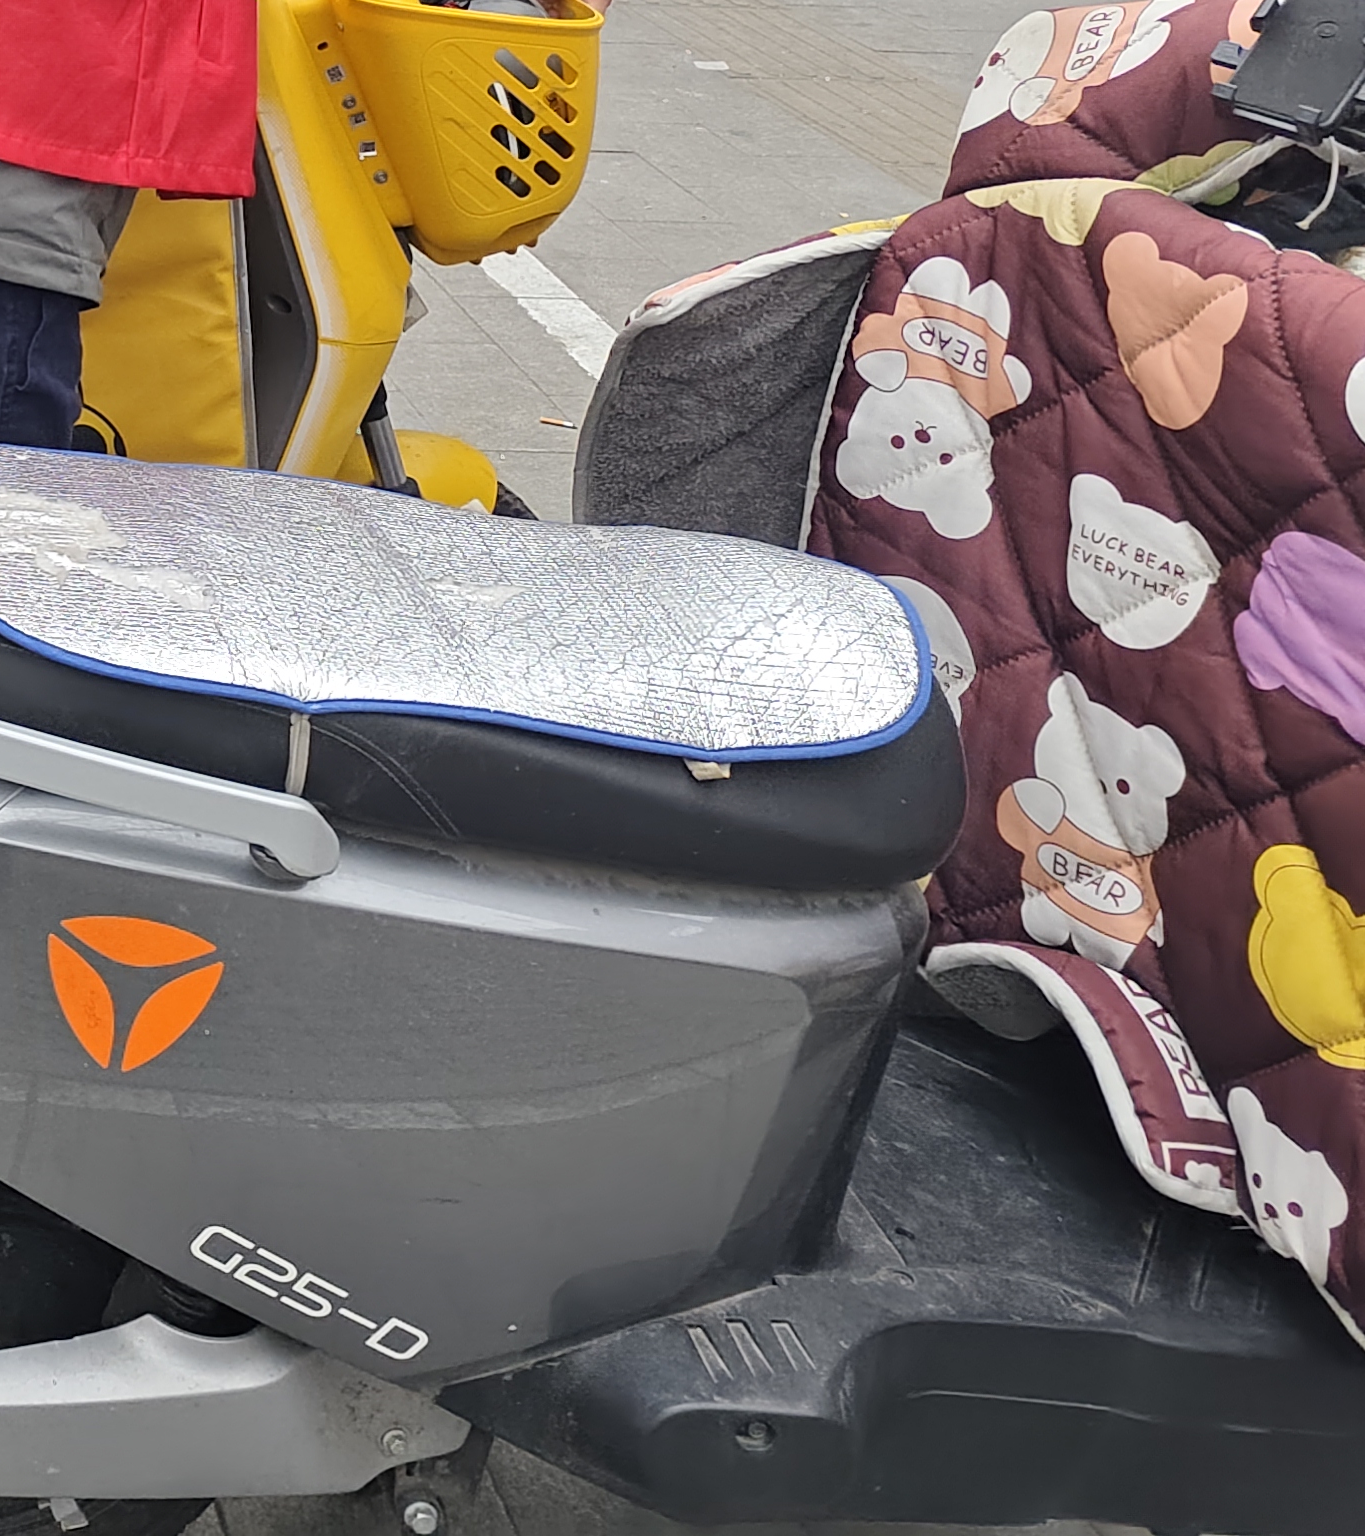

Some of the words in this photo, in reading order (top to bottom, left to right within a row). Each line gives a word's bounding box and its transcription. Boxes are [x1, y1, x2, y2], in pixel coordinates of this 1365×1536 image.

[1071, 9, 1117, 75] BEAR
[919, 319, 989, 374] BEAR
[1071, 543, 1189, 606] EVERYTHING
[1080, 524, 1129, 556] LUCK
[1133, 547, 1186, 580] BEAR
[1052, 851, 1128, 909] BEAR
[189, 1225, 429, 1360] G25-D
